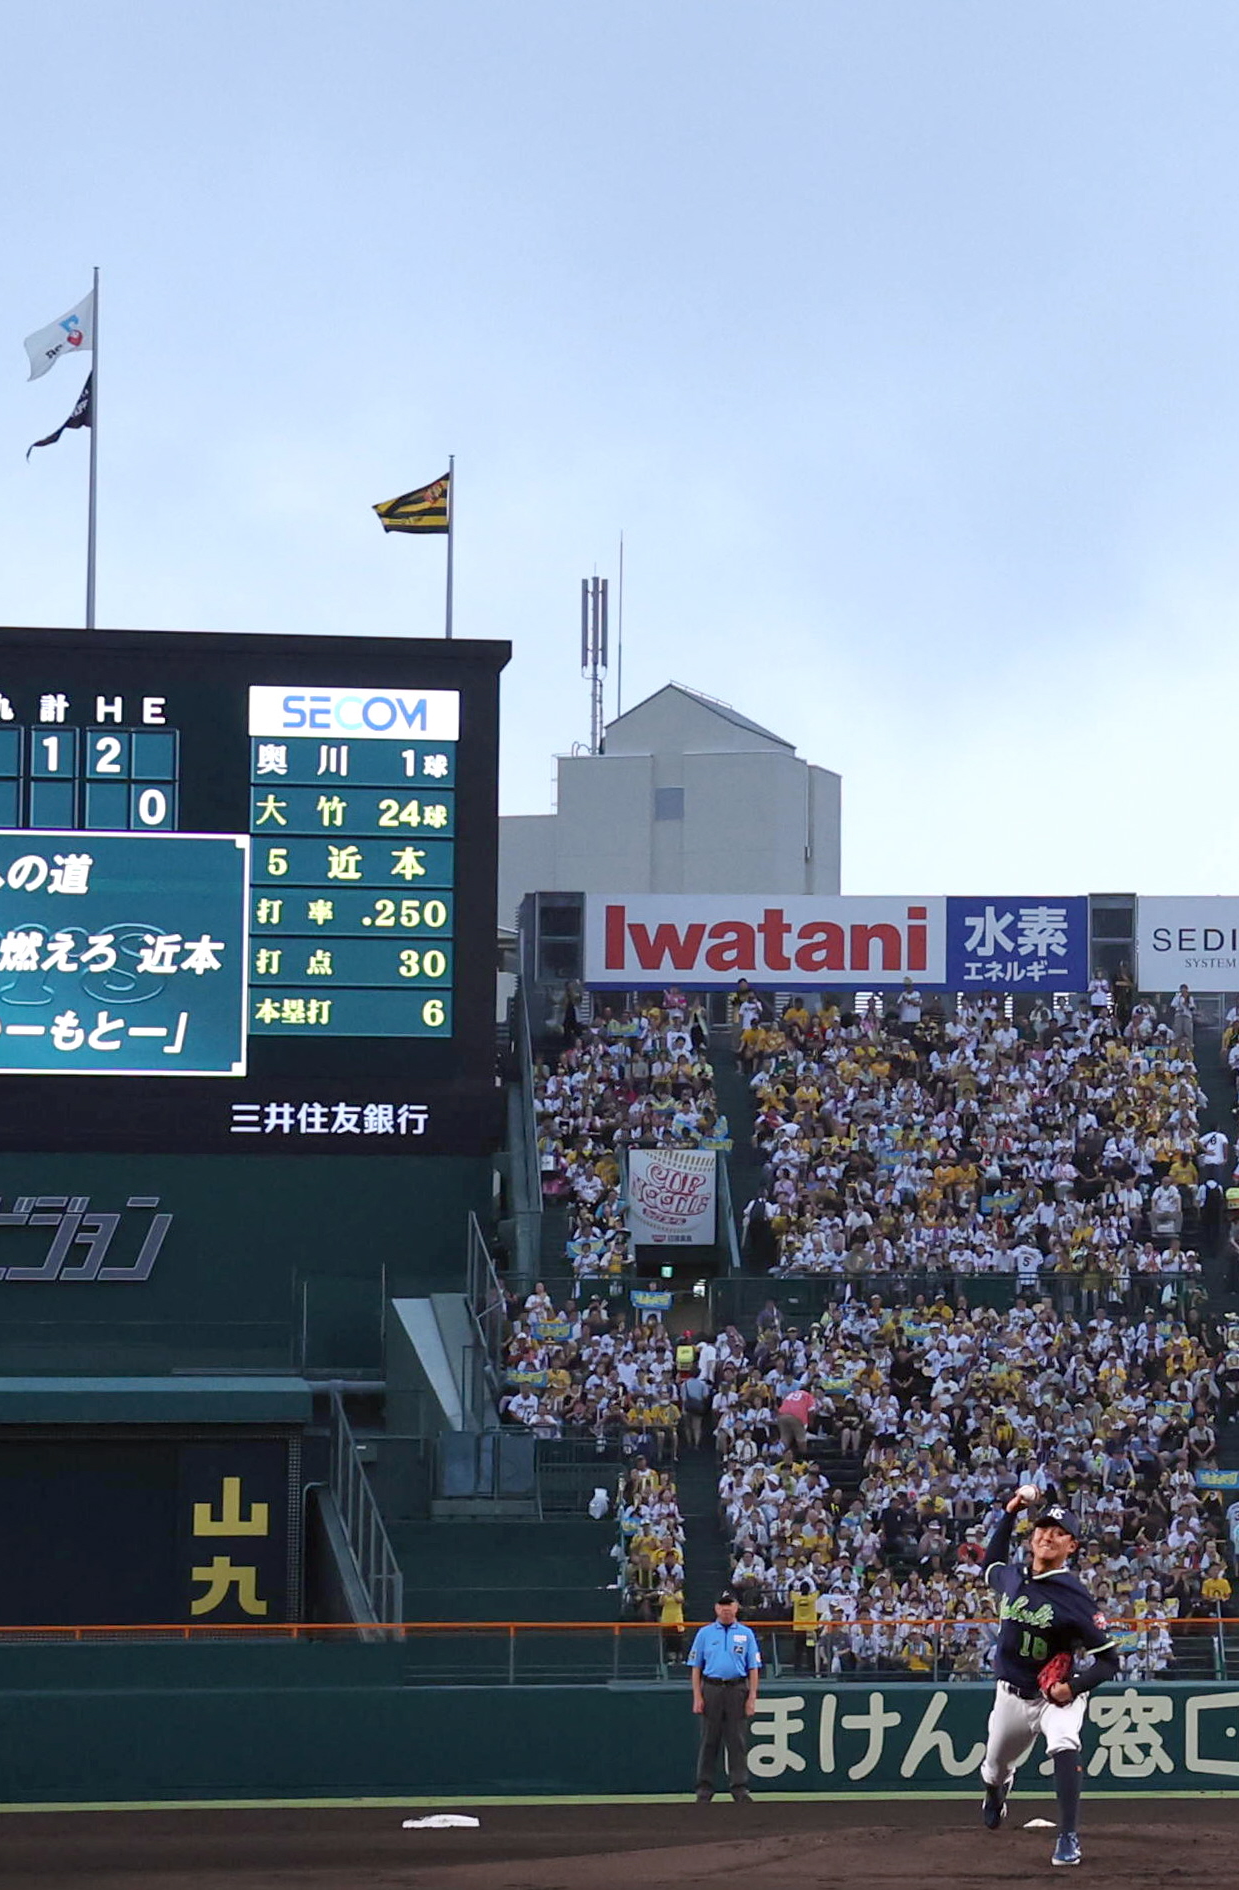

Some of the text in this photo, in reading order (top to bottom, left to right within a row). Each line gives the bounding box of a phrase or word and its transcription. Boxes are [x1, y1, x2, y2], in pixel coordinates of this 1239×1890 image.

[40, 694, 69, 722] 計
[97, 696, 122, 722] H
[143, 698, 165, 723] E
[283, 695, 426, 731] SECOM
[43, 737, 57, 771] 1
[96, 737, 120, 772] 2
[257, 744, 348, 776] 奥川
[139, 789, 165, 825] 0
[257, 795, 346, 826] 大竹
[268, 846, 425, 880] 5 近本
[257, 899, 446, 927] 打率 .250
[608, 907, 925, 970] Iwatani
[965, 907, 1067, 956] 水素
[137, 935, 224, 974] 近本
[256, 949, 445, 976] 打点 30
[964, 961, 1067, 981] エネルギー
[1184, 957, 1237, 969] SYSTEM
[256, 998, 444, 1026] 本塁打 6
[231, 1103, 428, 1134] 三井住友銀行
[192, 1478, 267, 1614] 山九
[724, 1688, 1239, 1780] ほけん窓口
